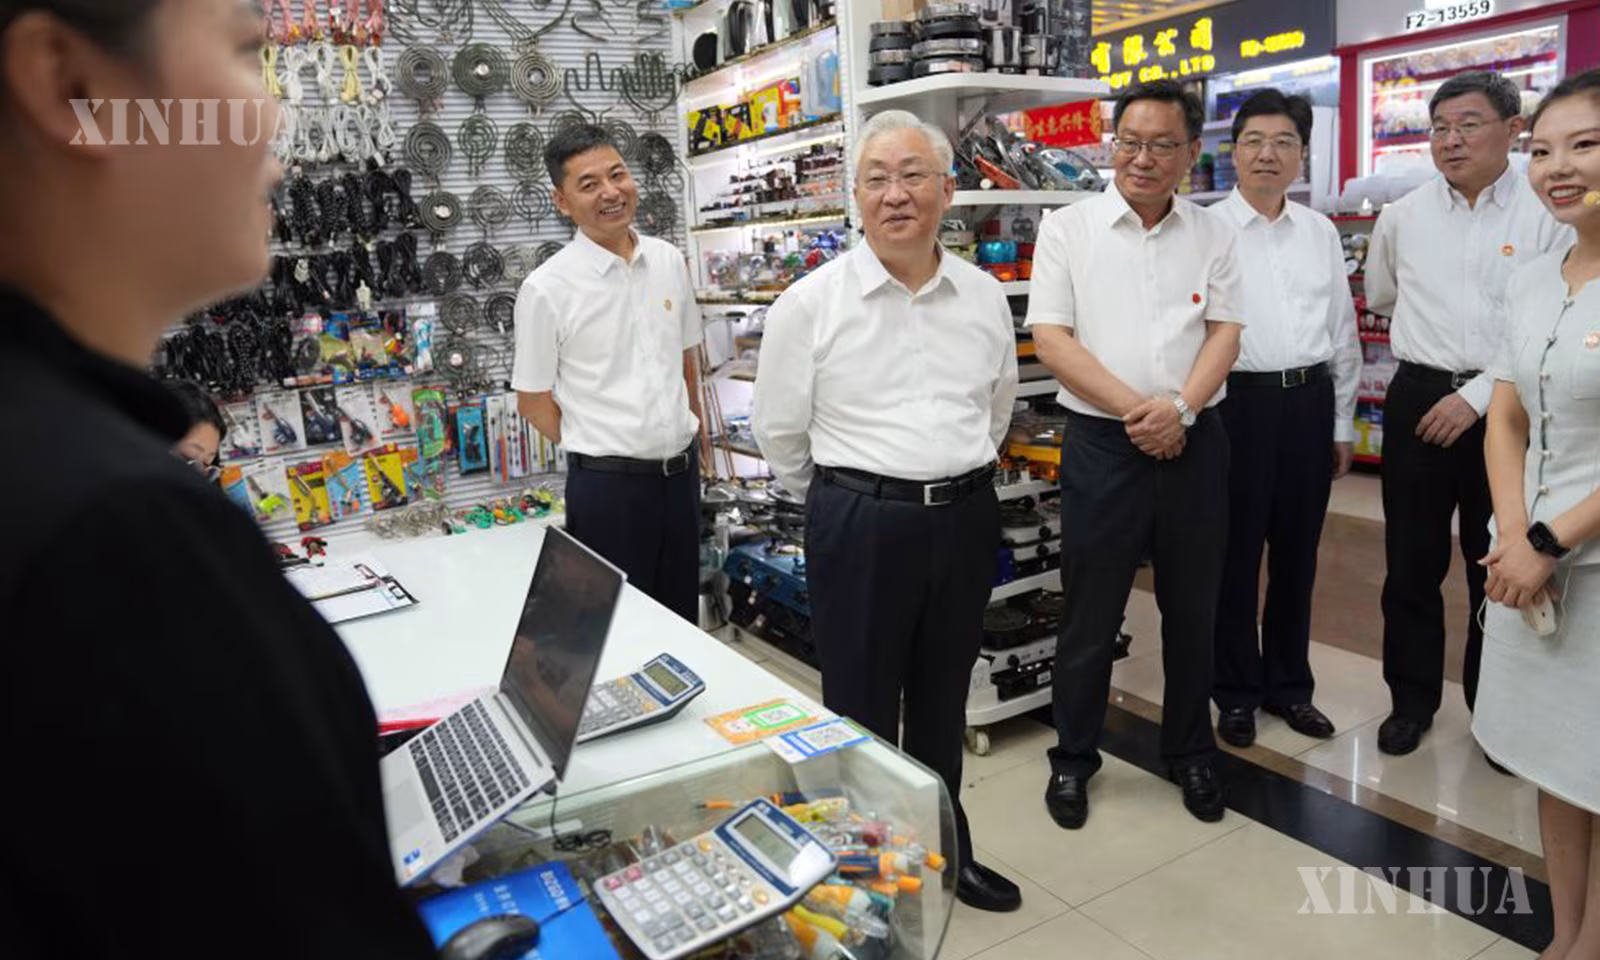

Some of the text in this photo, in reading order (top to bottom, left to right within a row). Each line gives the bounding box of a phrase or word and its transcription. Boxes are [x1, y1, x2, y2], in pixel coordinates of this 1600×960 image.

[1405, 1, 1490, 29] F2-13559
[1091, 17, 1212, 73] 有限公司
